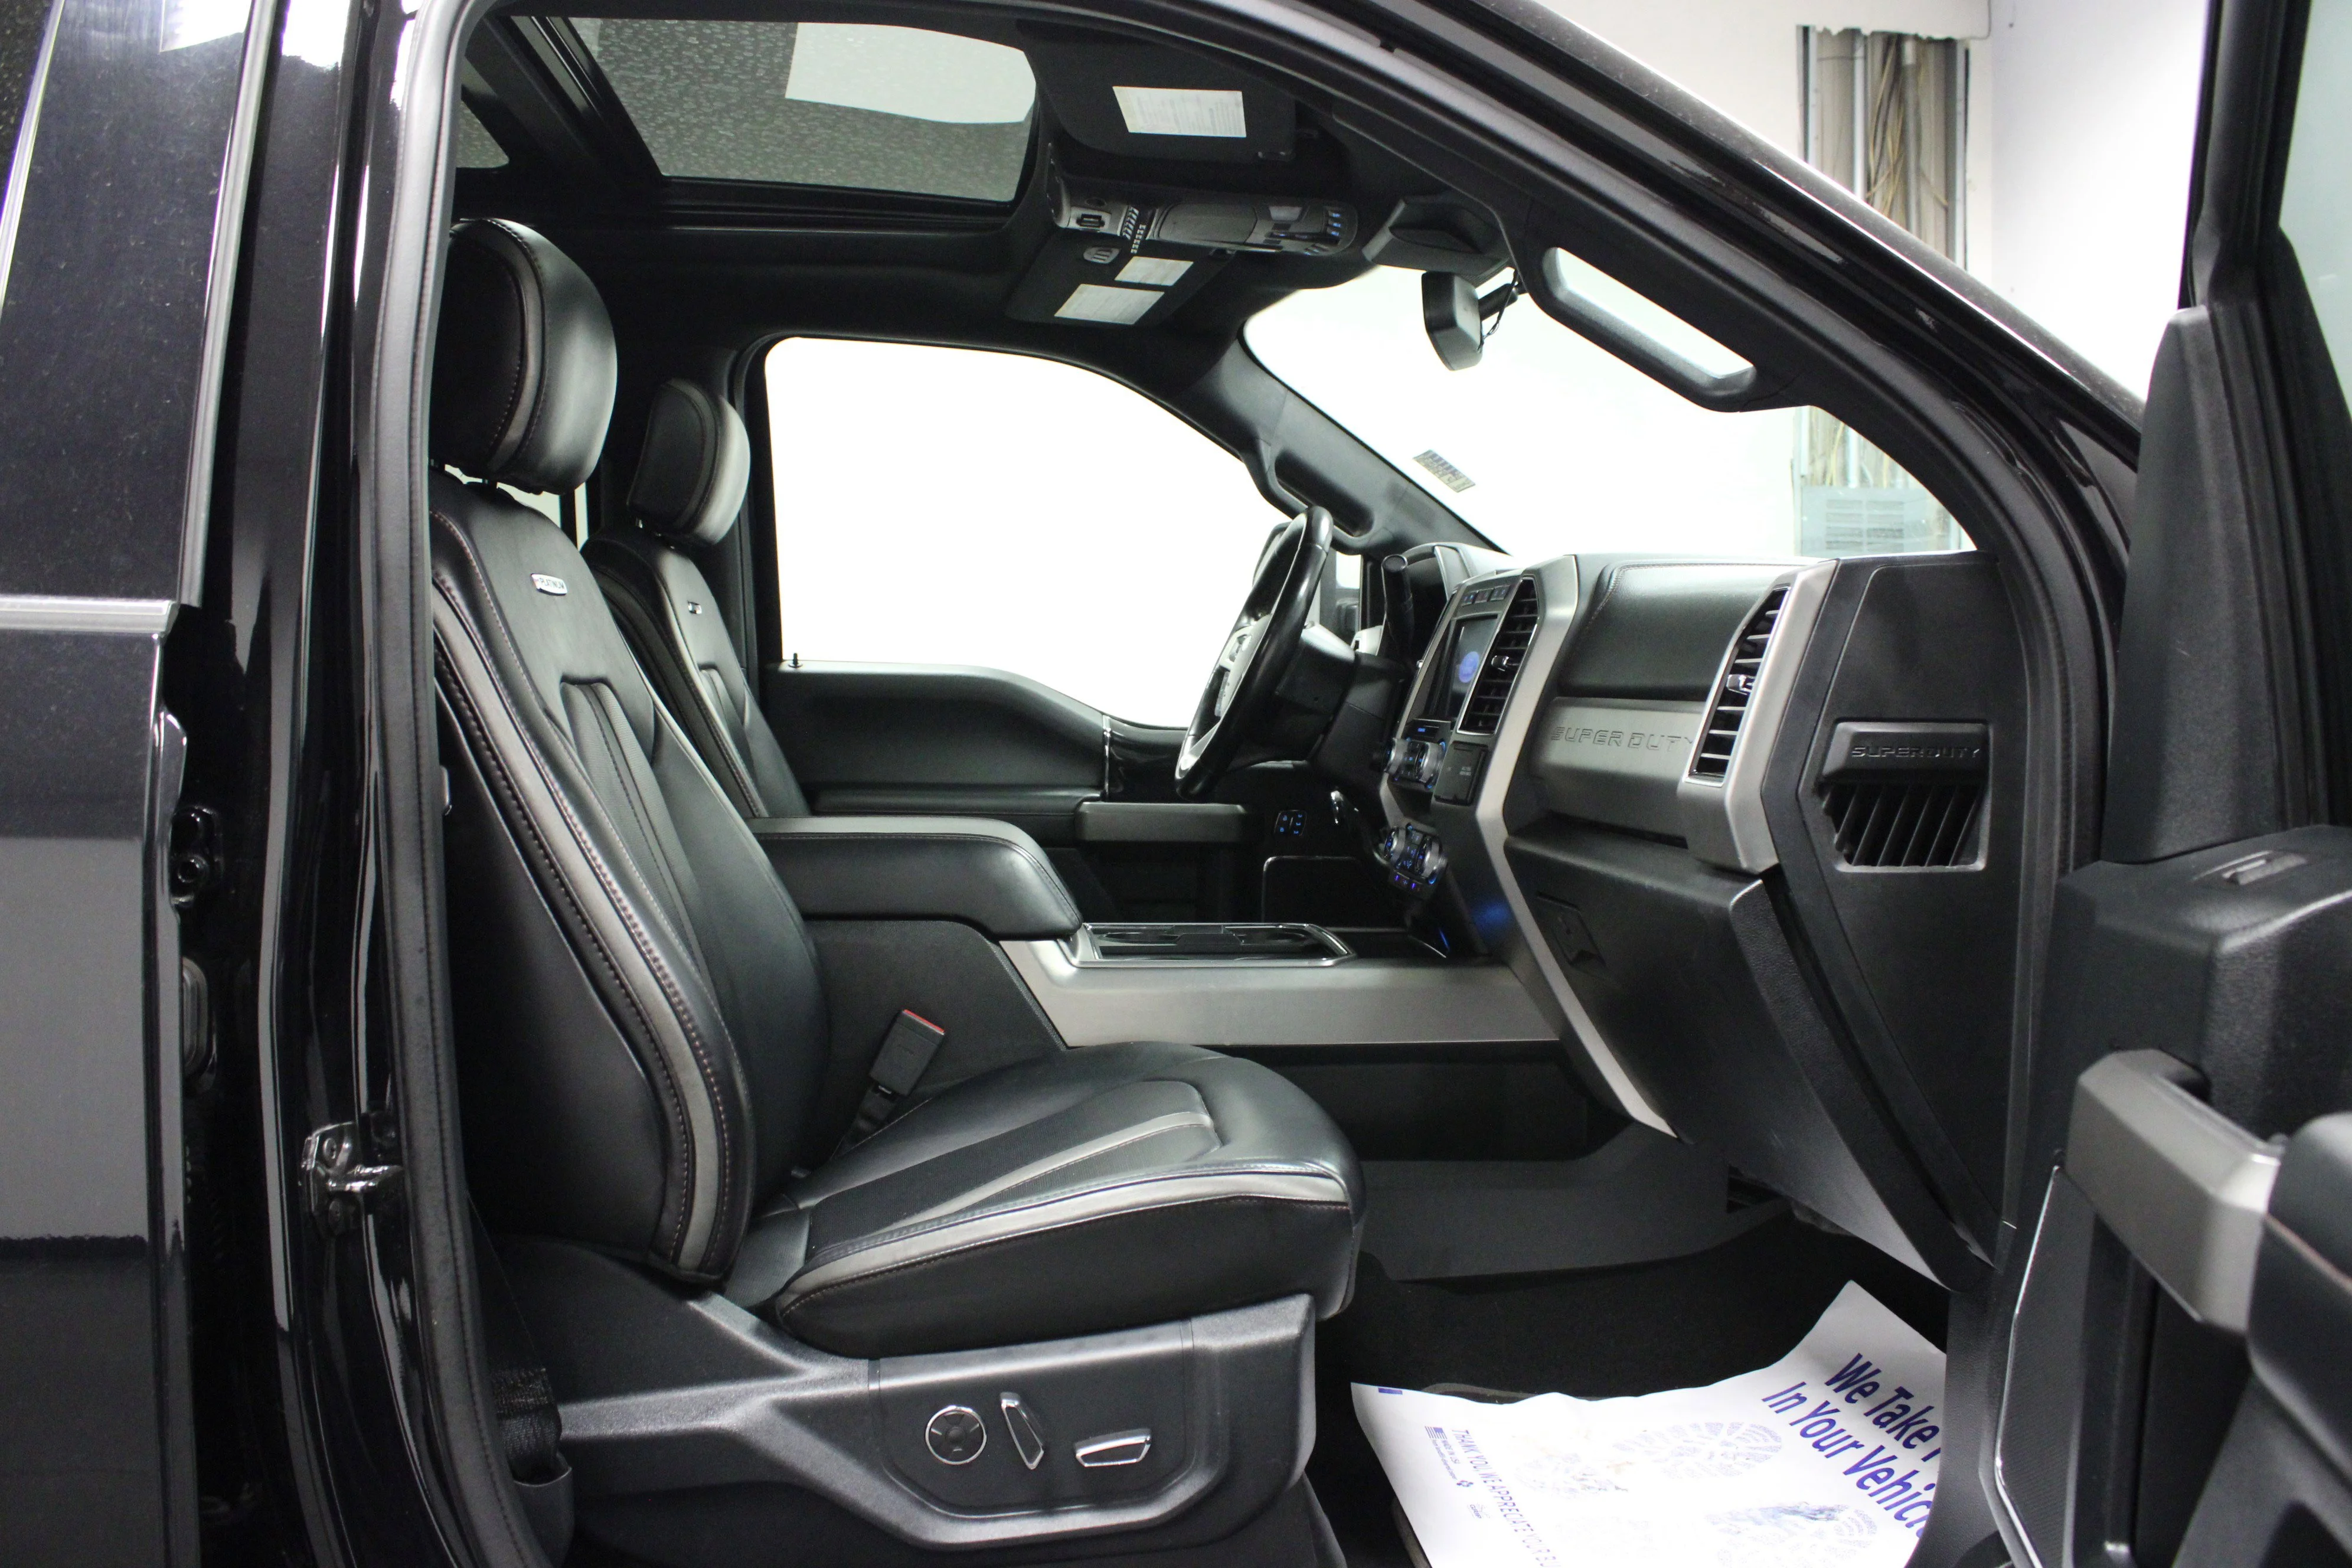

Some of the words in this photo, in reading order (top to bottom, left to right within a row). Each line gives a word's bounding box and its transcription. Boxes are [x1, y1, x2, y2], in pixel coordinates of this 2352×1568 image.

[1551, 727, 1623, 747] SUPER
[1851, 747, 1923, 757] SUPER
[1926, 747, 1980, 758] DUTY
[1824, 1353, 1881, 1403] We
[1864, 1386, 1939, 1449] Take
[1762, 1381, 1807, 1413] In
[1789, 1400, 1864, 1458] Your
[1452, 1429, 1482, 1453] THANK
[1478, 1472, 1502, 1483] WE
[1487, 1485, 1534, 1532] APPRECIATE
[1522, 1533, 1551, 1554] YOUR
